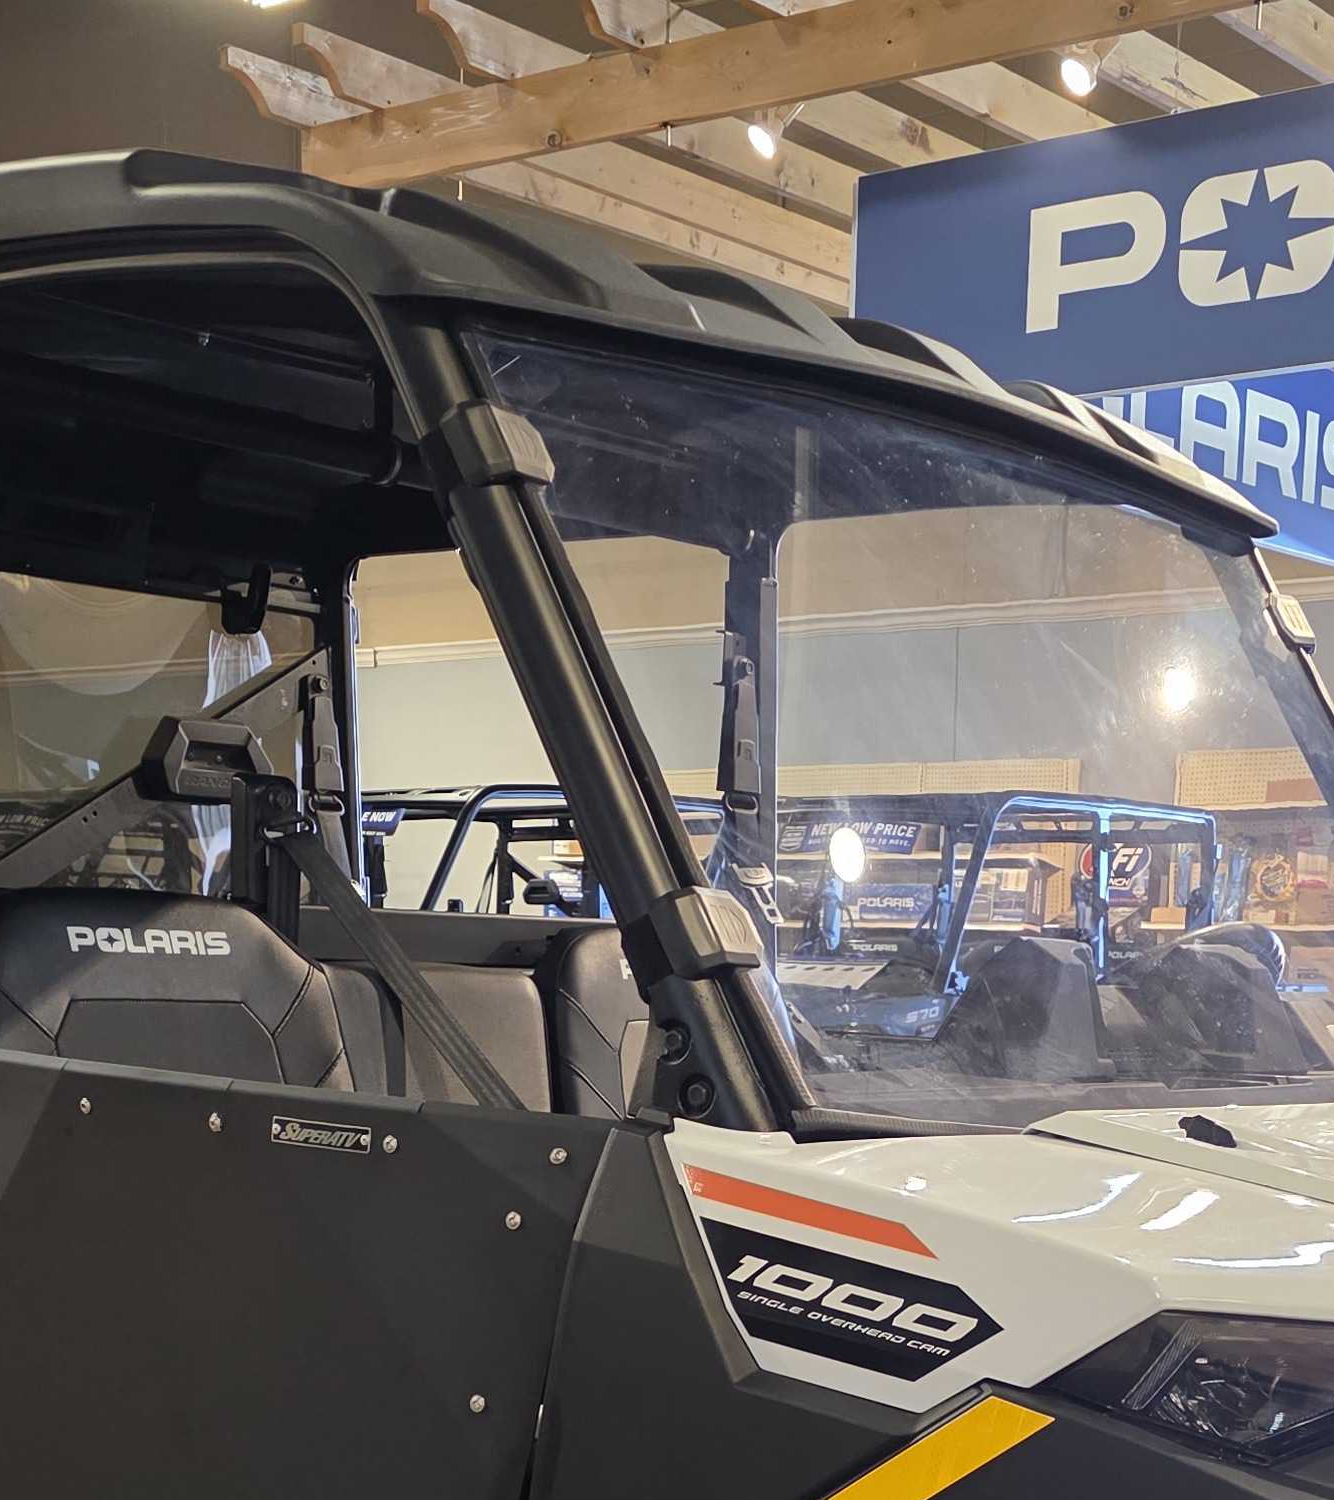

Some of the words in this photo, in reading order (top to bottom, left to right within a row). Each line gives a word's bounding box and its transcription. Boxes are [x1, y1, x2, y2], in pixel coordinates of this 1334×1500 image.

[369, 811, 396, 822] NOW
[873, 822, 917, 838] PRICE
[857, 897, 915, 907] POLARIS
[66, 926, 231, 956] POLARIS
[727, 1254, 979, 1342] 1000
[737, 1290, 804, 1315] SINGLE
[807, 1312, 906, 1345] OVERHEAD
[906, 1340, 951, 1357] CAM
